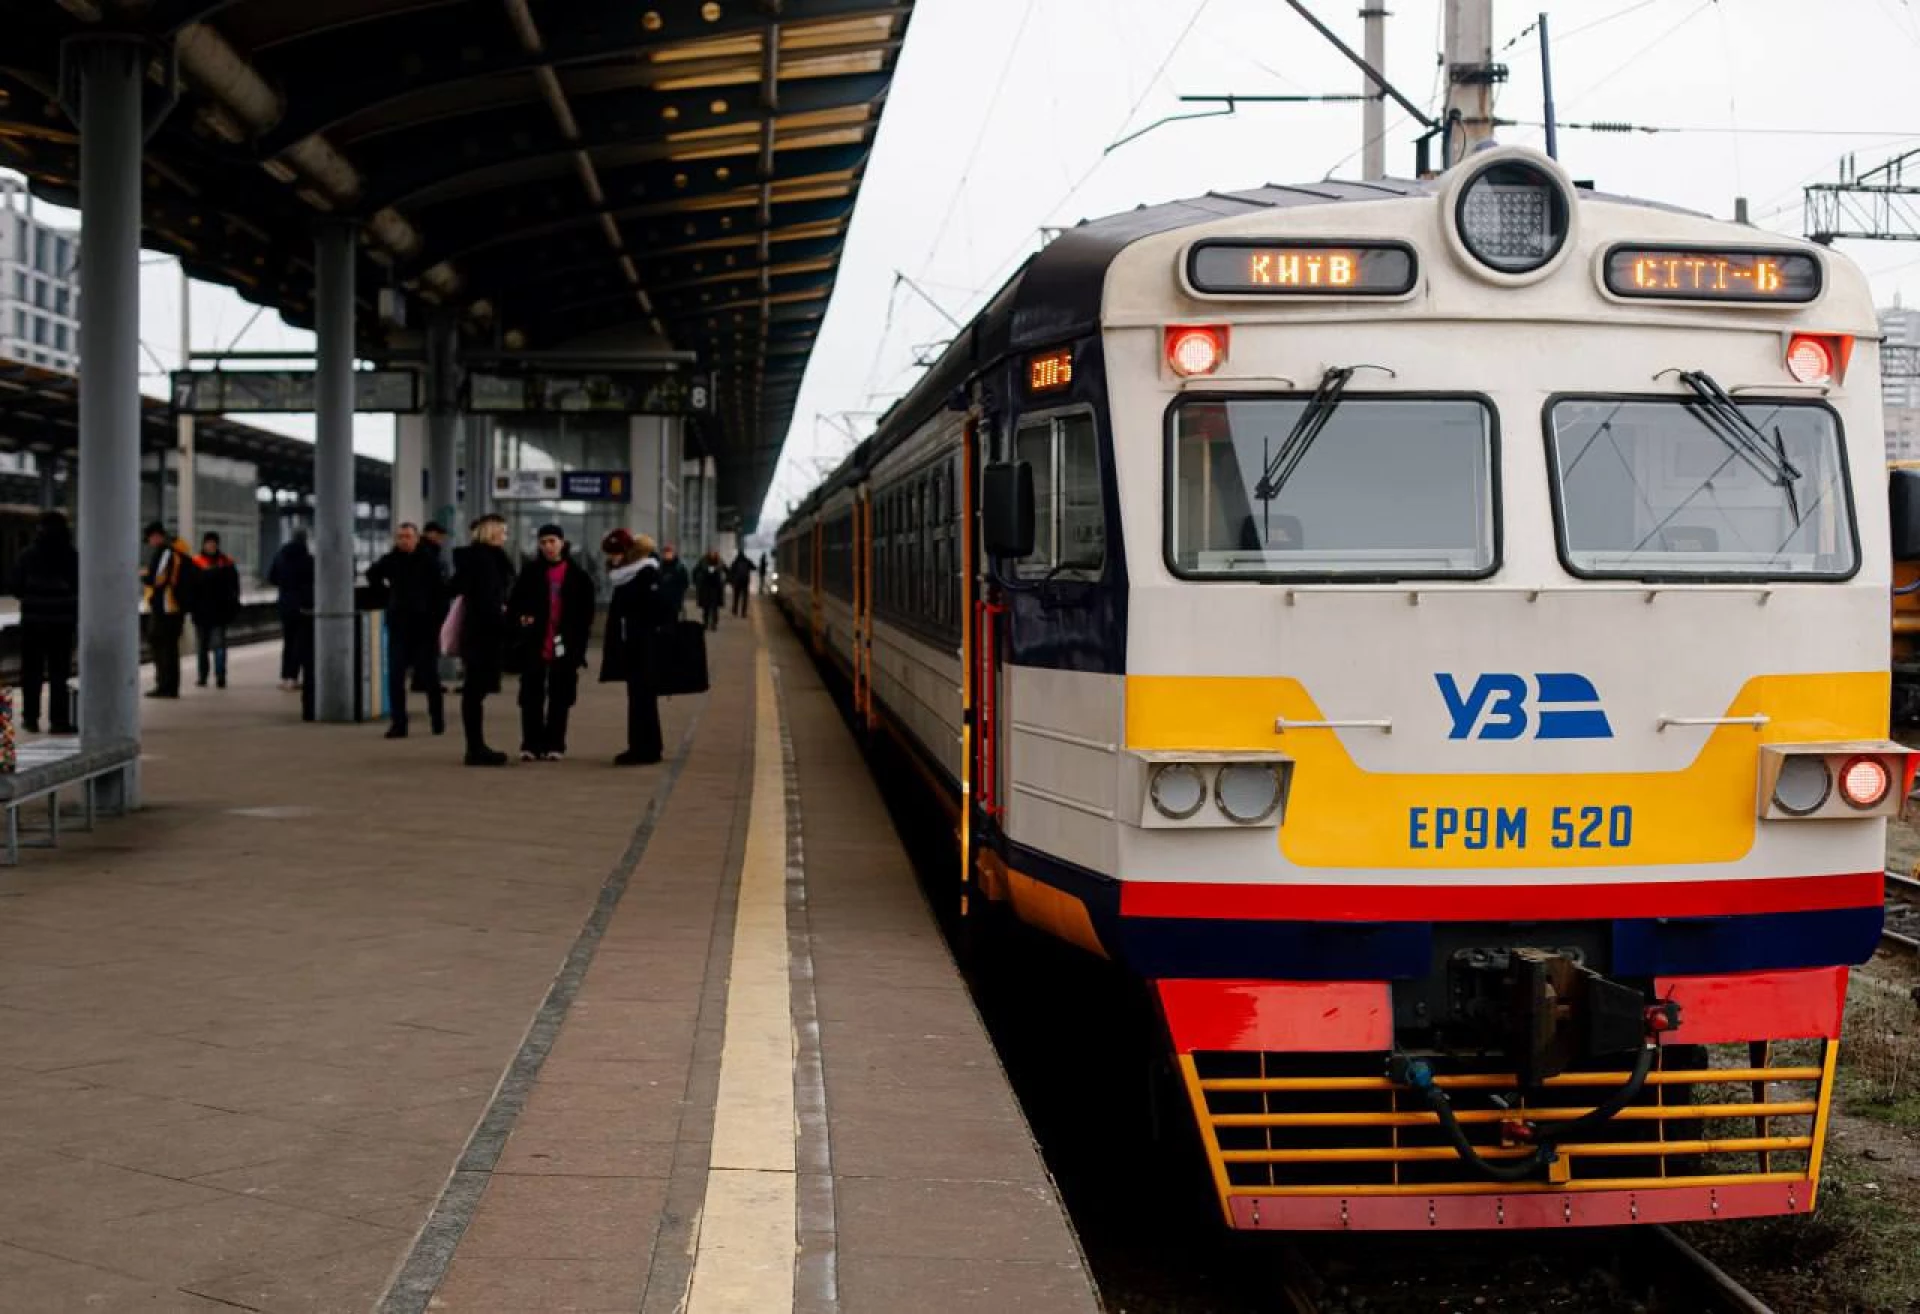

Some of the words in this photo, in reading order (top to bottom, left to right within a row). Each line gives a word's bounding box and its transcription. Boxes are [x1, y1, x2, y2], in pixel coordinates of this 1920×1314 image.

[1253, 255, 1350, 284] КИЇВ
[692, 386, 706, 409] 8
[1409, 806, 1527, 849] ЕР9М
[1551, 805, 1633, 848] 520
